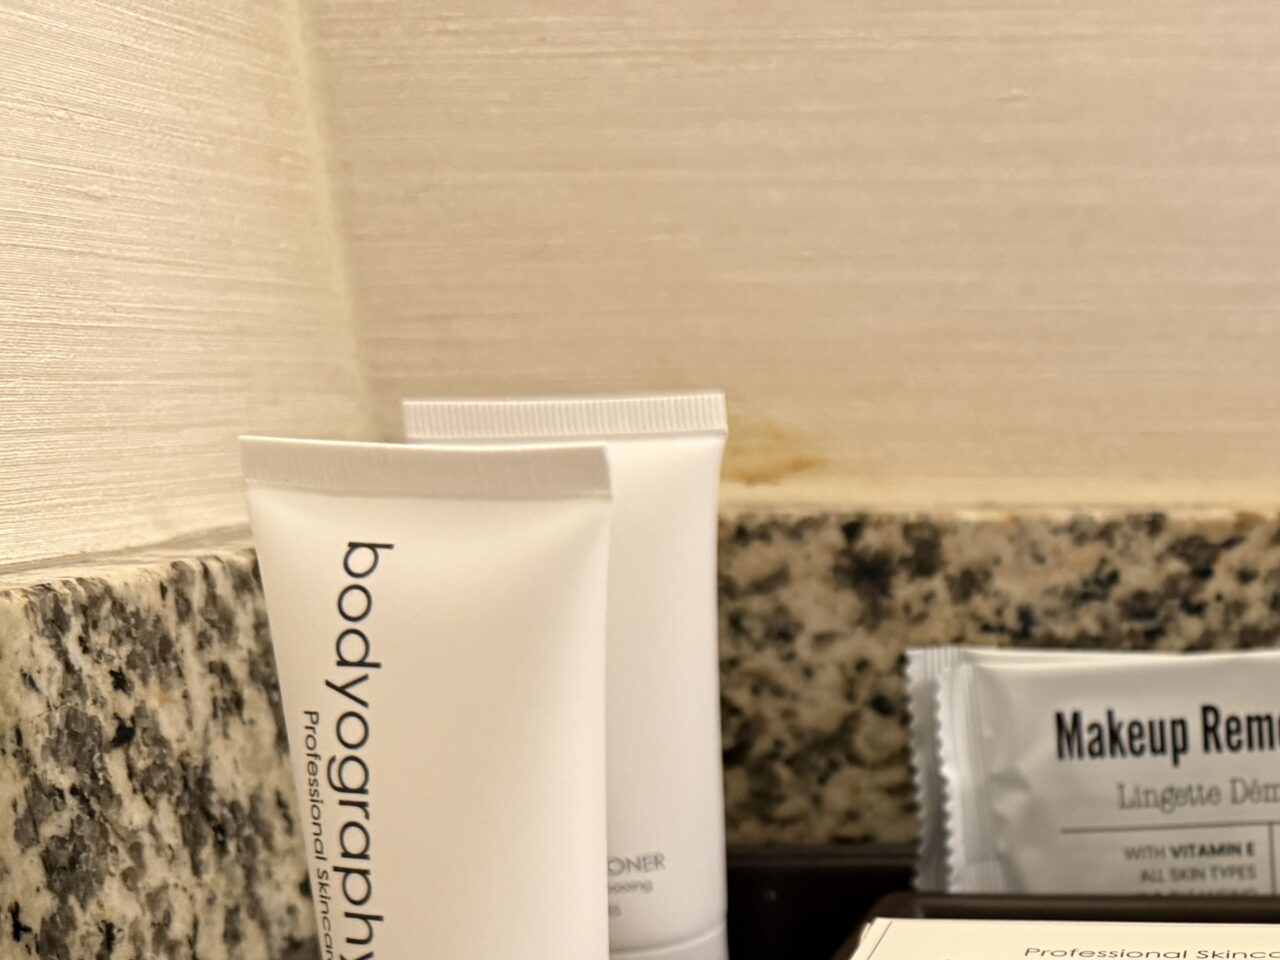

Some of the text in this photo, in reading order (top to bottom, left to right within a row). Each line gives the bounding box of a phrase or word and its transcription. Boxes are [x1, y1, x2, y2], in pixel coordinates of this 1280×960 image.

[1054, 708, 1190, 767] Makeup
[303, 709, 328, 861] Professional
[1116, 781, 1222, 814] Lingette
[1124, 840, 1256, 861] WITH VITAMIN E
[1140, 864, 1257, 883] ALL SKIN TYPES
[1024, 947, 1188, 959] Professional
